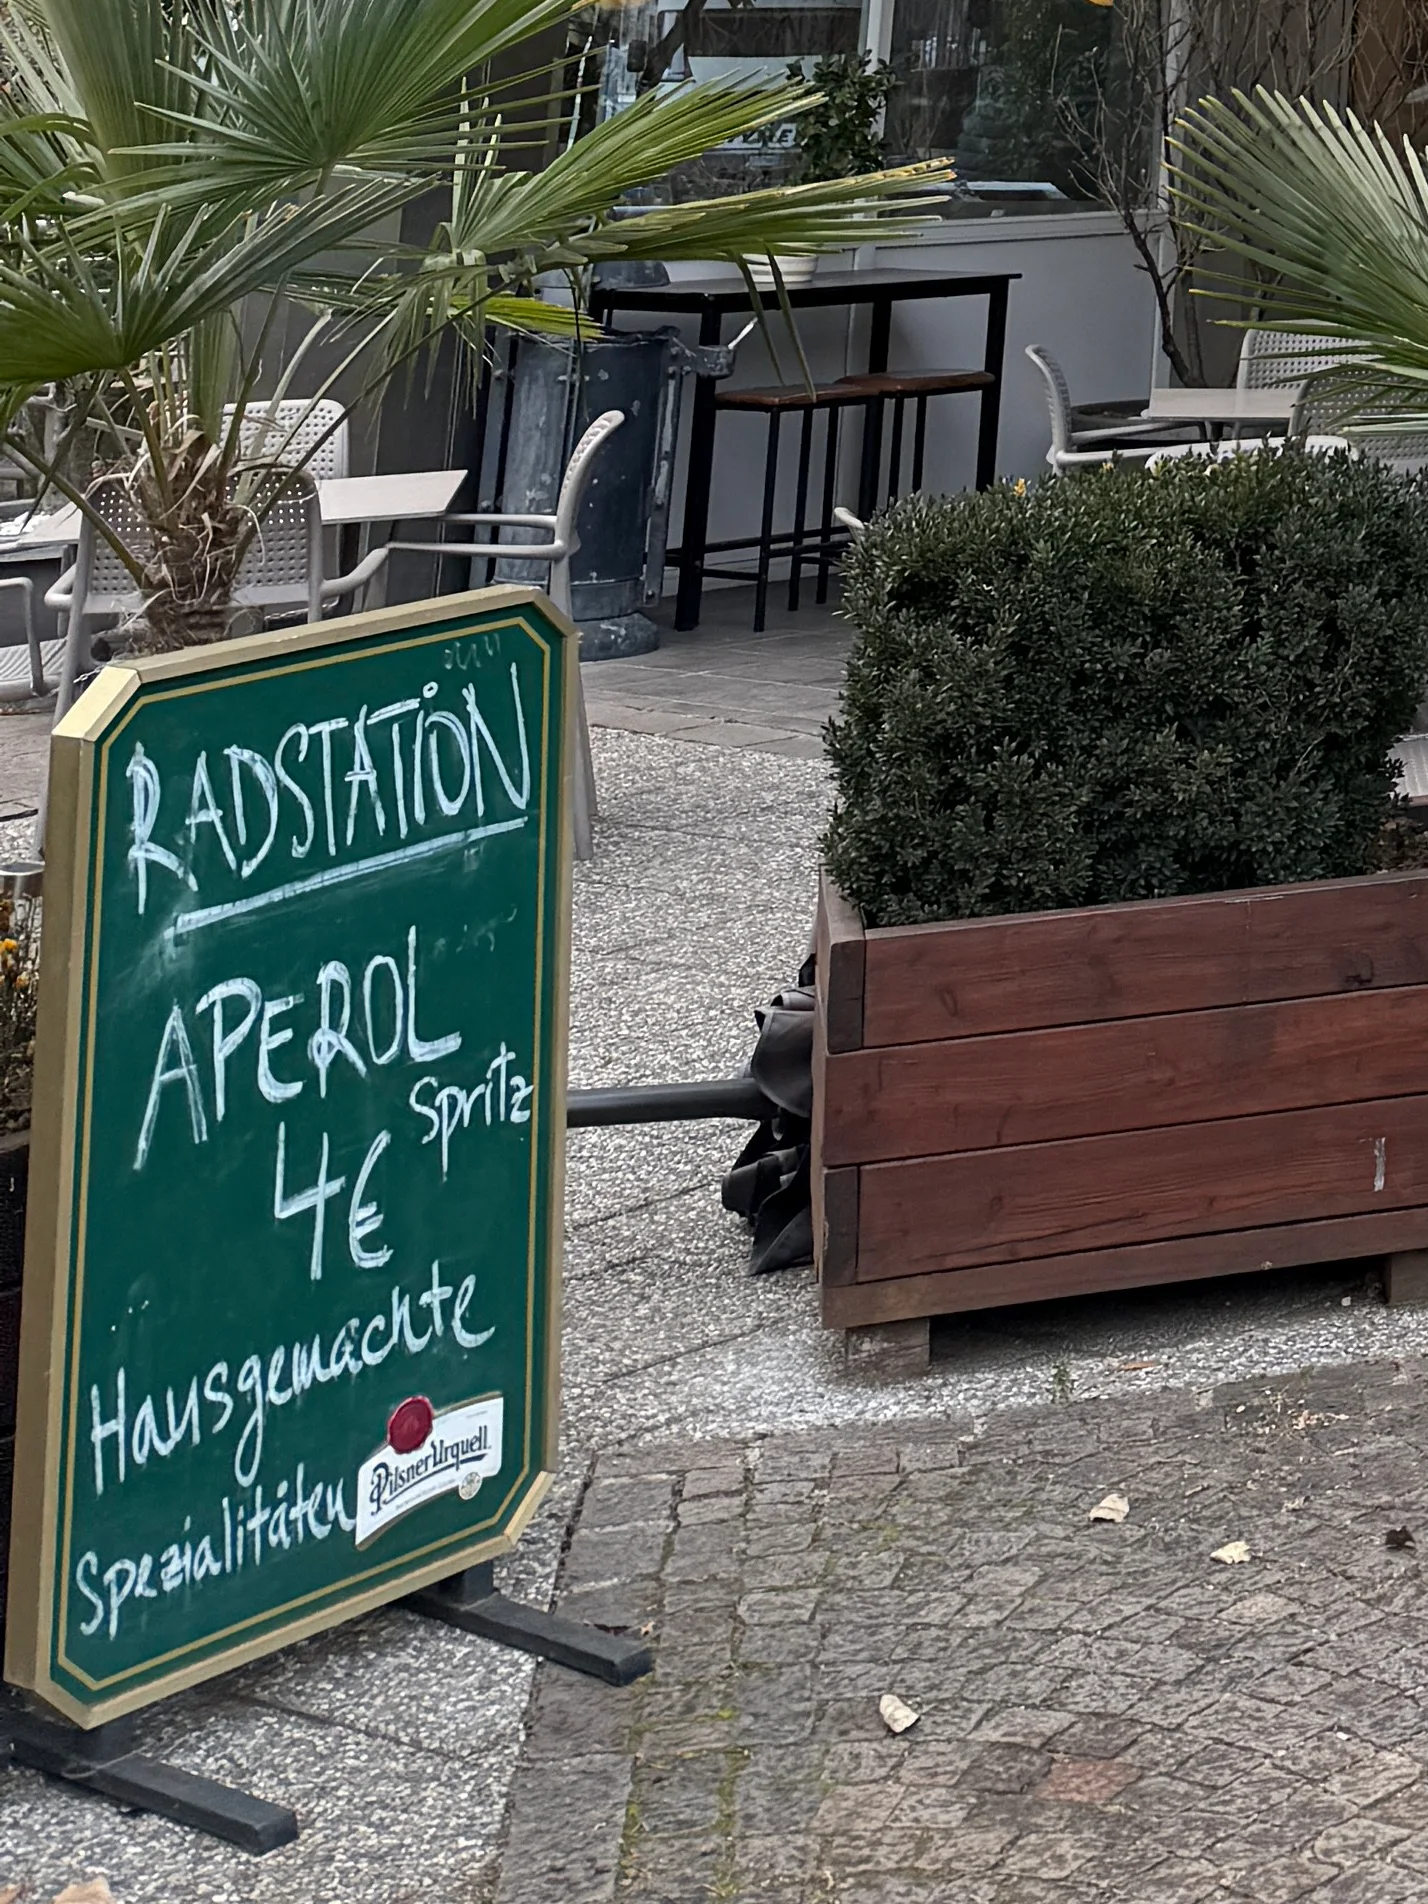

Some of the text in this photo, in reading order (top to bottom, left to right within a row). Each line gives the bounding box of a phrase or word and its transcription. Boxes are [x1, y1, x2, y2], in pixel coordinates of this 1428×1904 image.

[133, 925, 462, 1171] APEROL
[409, 1041, 534, 1181] Spritz
[273, 1121, 394, 1280] 4€
[90, 1259, 495, 1495] Hausgemachte
[369, 1454, 432, 1516] Pilsner
[431, 1425, 487, 1471] Urquell
